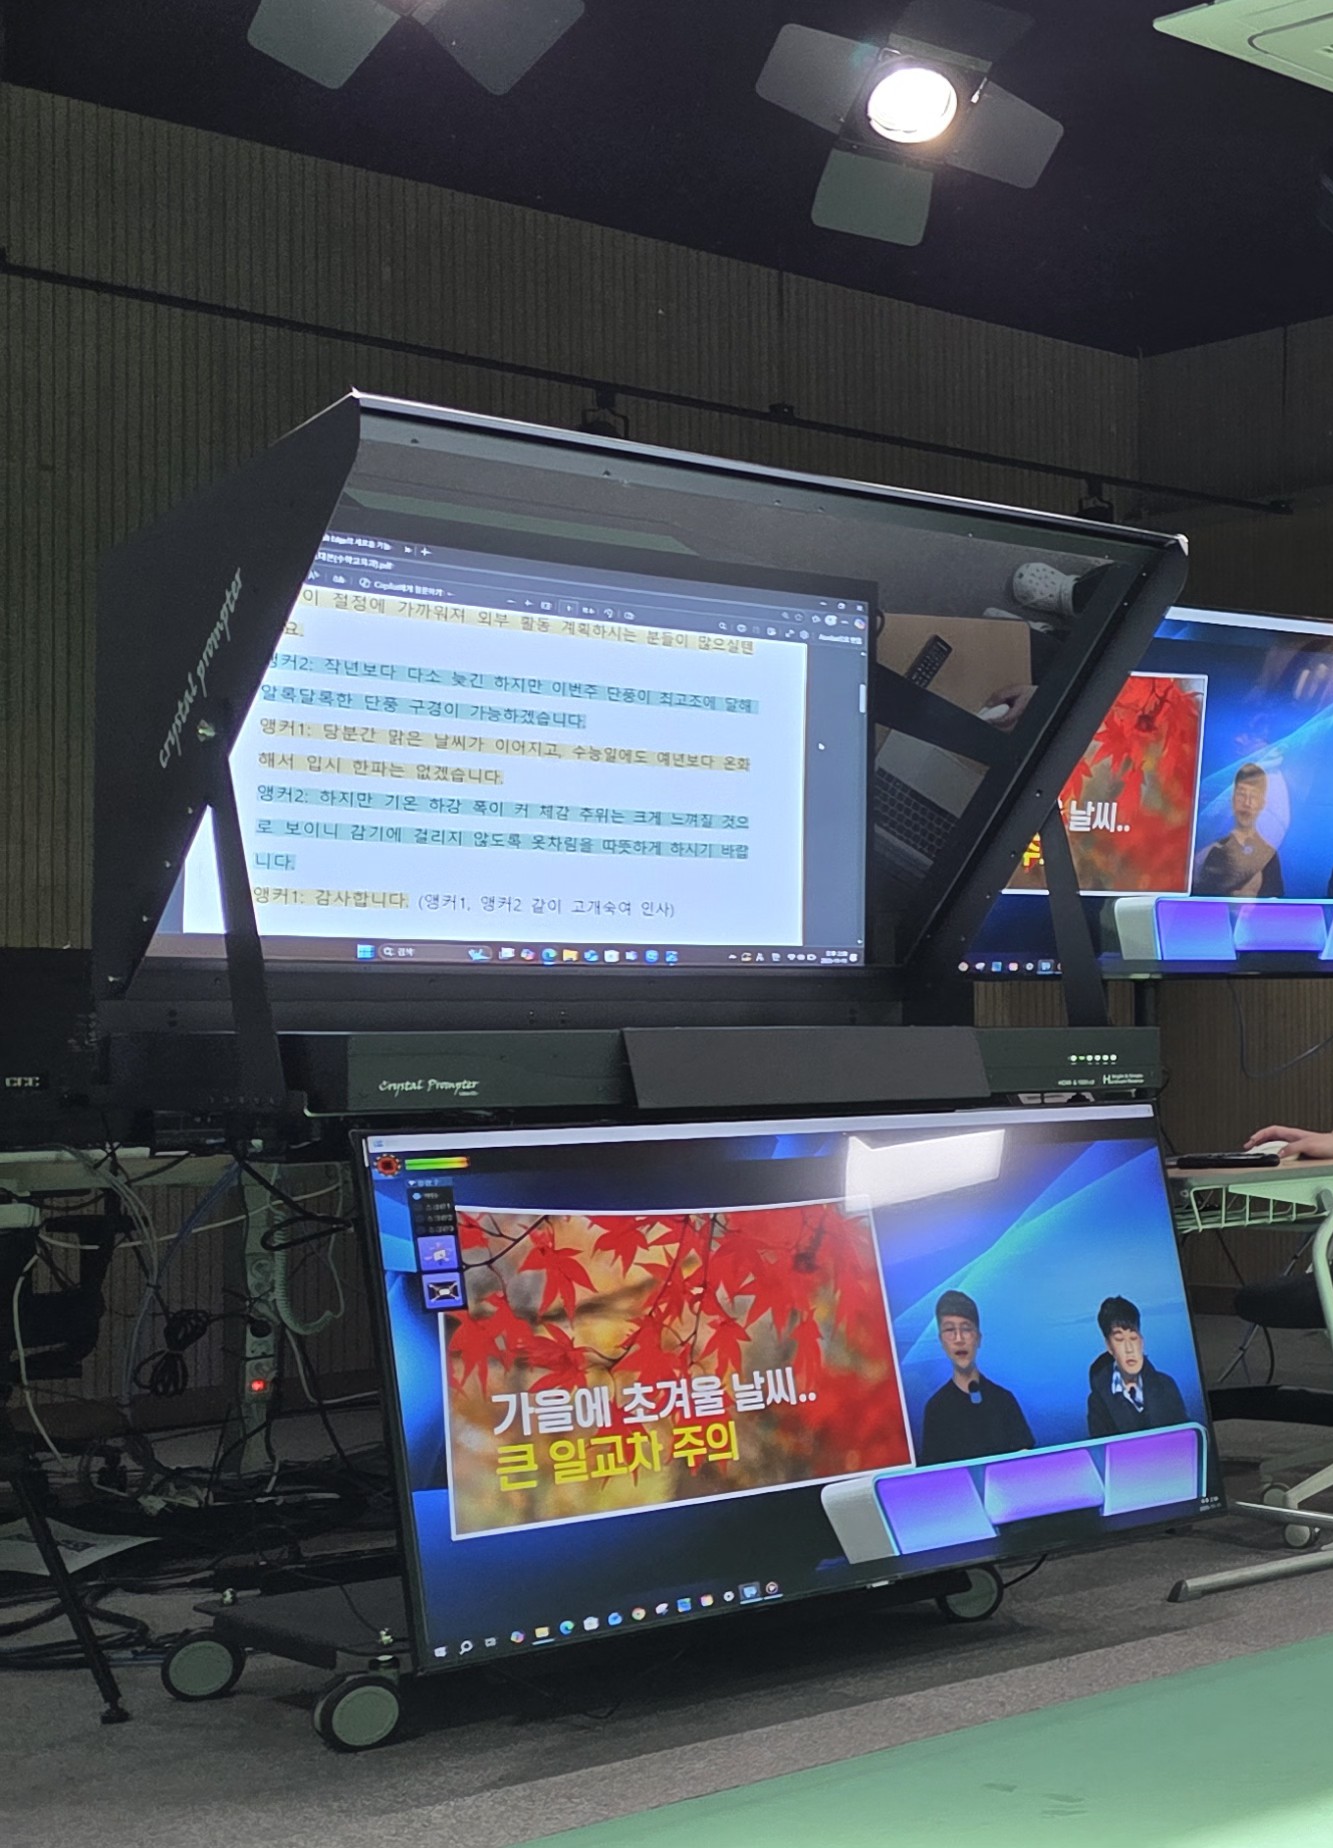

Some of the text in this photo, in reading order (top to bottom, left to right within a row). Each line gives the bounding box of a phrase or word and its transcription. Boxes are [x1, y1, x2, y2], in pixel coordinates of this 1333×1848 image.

[332, 591, 386, 614] 절정에
[398, 599, 466, 625] 가까워져
[477, 610, 511, 629] 외부
[519, 615, 551, 634] 활동
[561, 619, 638, 644] 계획하시는
[646, 629, 690, 649] 분들이
[698, 634, 754, 656] 많으실텐
[260, 684, 586, 730] 알록달록한 단풍 구경이 가능하겠습니다.
[323, 657, 397, 679] 작년보다
[407, 666, 442, 684] 다소
[451, 669, 484, 690] 늦긴
[493, 674, 544, 695] 하지만
[551, 680, 599, 701] 이번주
[606, 685, 651, 704] 단풍이
[659, 691, 717, 711] 최고조에
[724, 697, 752, 714] 달해
[259, 717, 751, 772] 앵커1: 당분간 맑은 날씨가 이어지고, 수능일에도 예년보다 온화
[258, 751, 505, 786] 해서 입시 한파는 없겠습니다.
[257, 784, 750, 830] 앵커2: 하지만 기온 하강 폭이 커 체감 추위는 크게 느껴질 것으
[1067, 799, 1132, 834] 날씨..
[254, 852, 296, 871] 니다.
[256, 819, 749, 860] 로 보이니 감기에 걸리지 않도록 옷차림을 따뜻하게 하시기 바랍
[252, 886, 676, 918] 앵커1: 감사합니다. (앵커1, 앵커2 같이 고개숙여 인사)
[378, 1078, 480, 1098] Crystal Prompter
[491, 1366, 817, 1436] 가을에 초겨울 날씨..
[496, 1420, 740, 1492] 큰 일교차 주의
